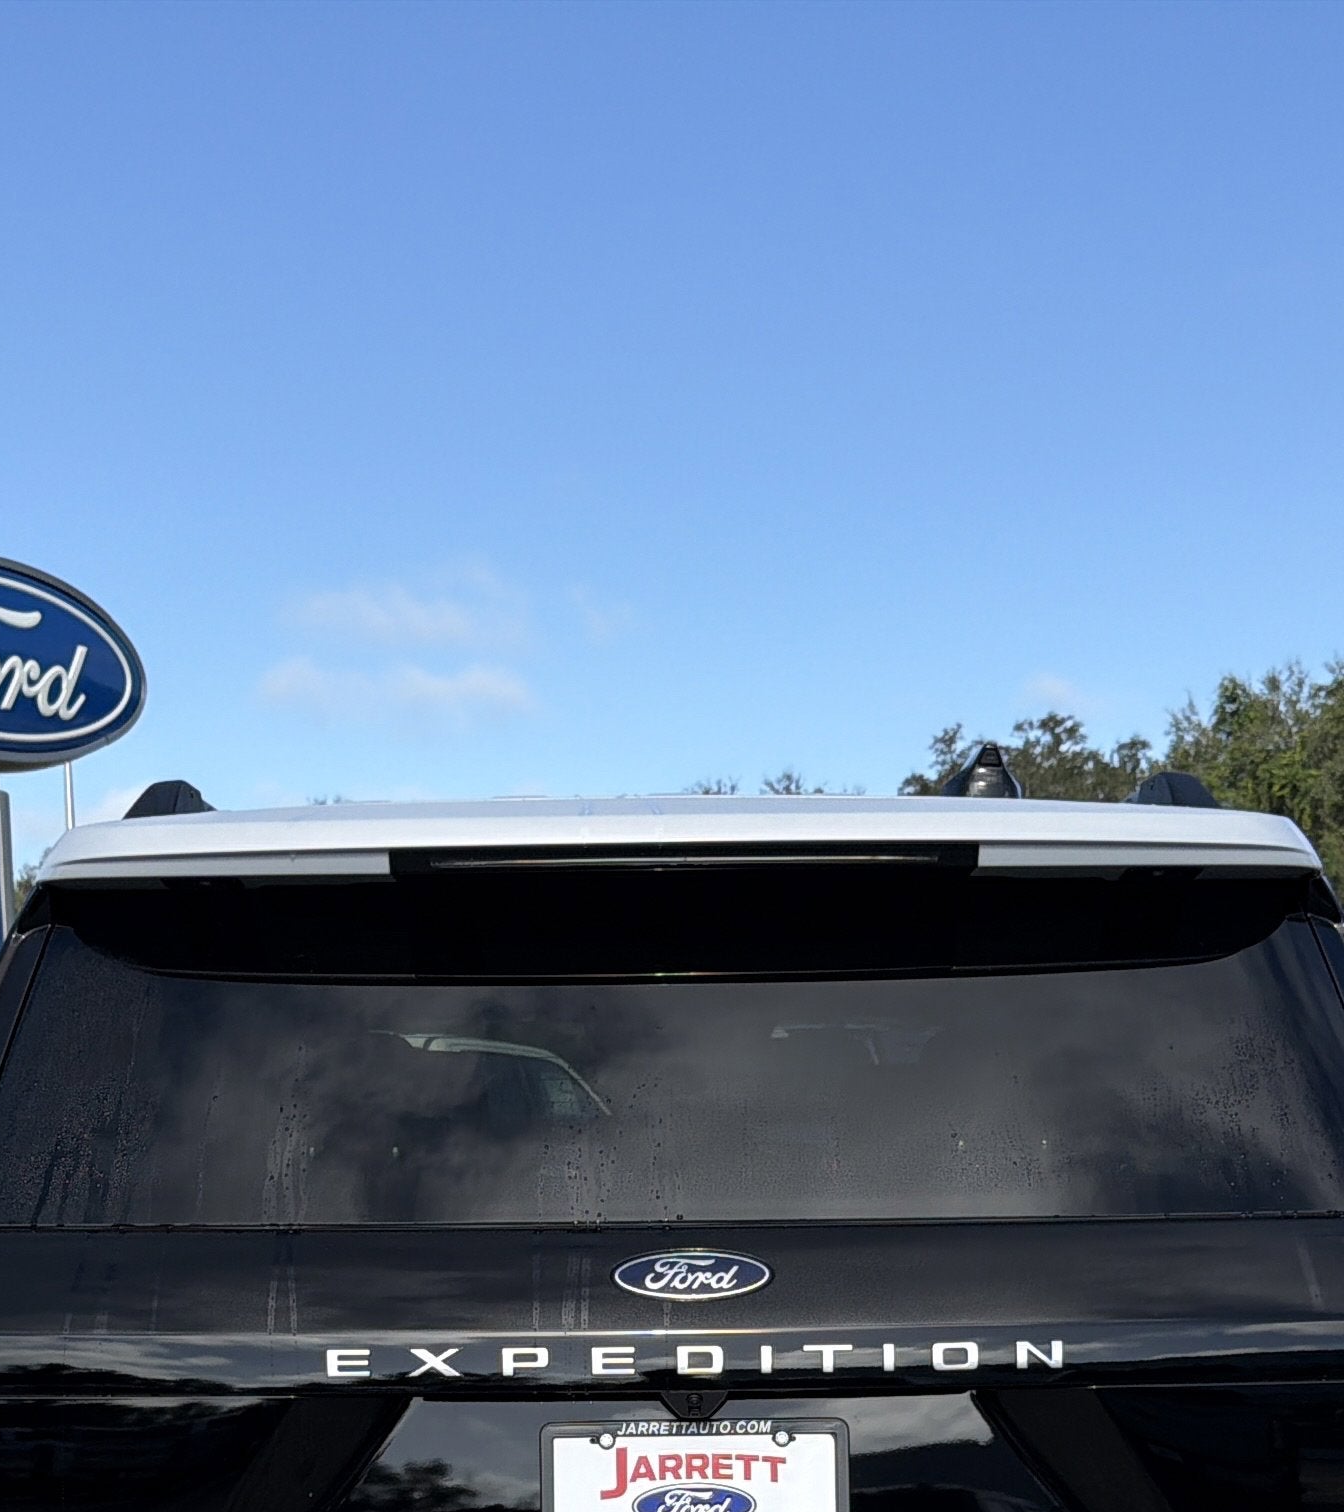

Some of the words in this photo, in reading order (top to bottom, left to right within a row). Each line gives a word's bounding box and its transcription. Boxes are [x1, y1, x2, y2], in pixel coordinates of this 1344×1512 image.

[644, 1258, 739, 1290] Ford
[326, 1339, 1064, 1378] EXPEDITION
[617, 1420, 772, 1436] JARRETTAUTO.COM
[600, 1446, 787, 1500] JARRETT
